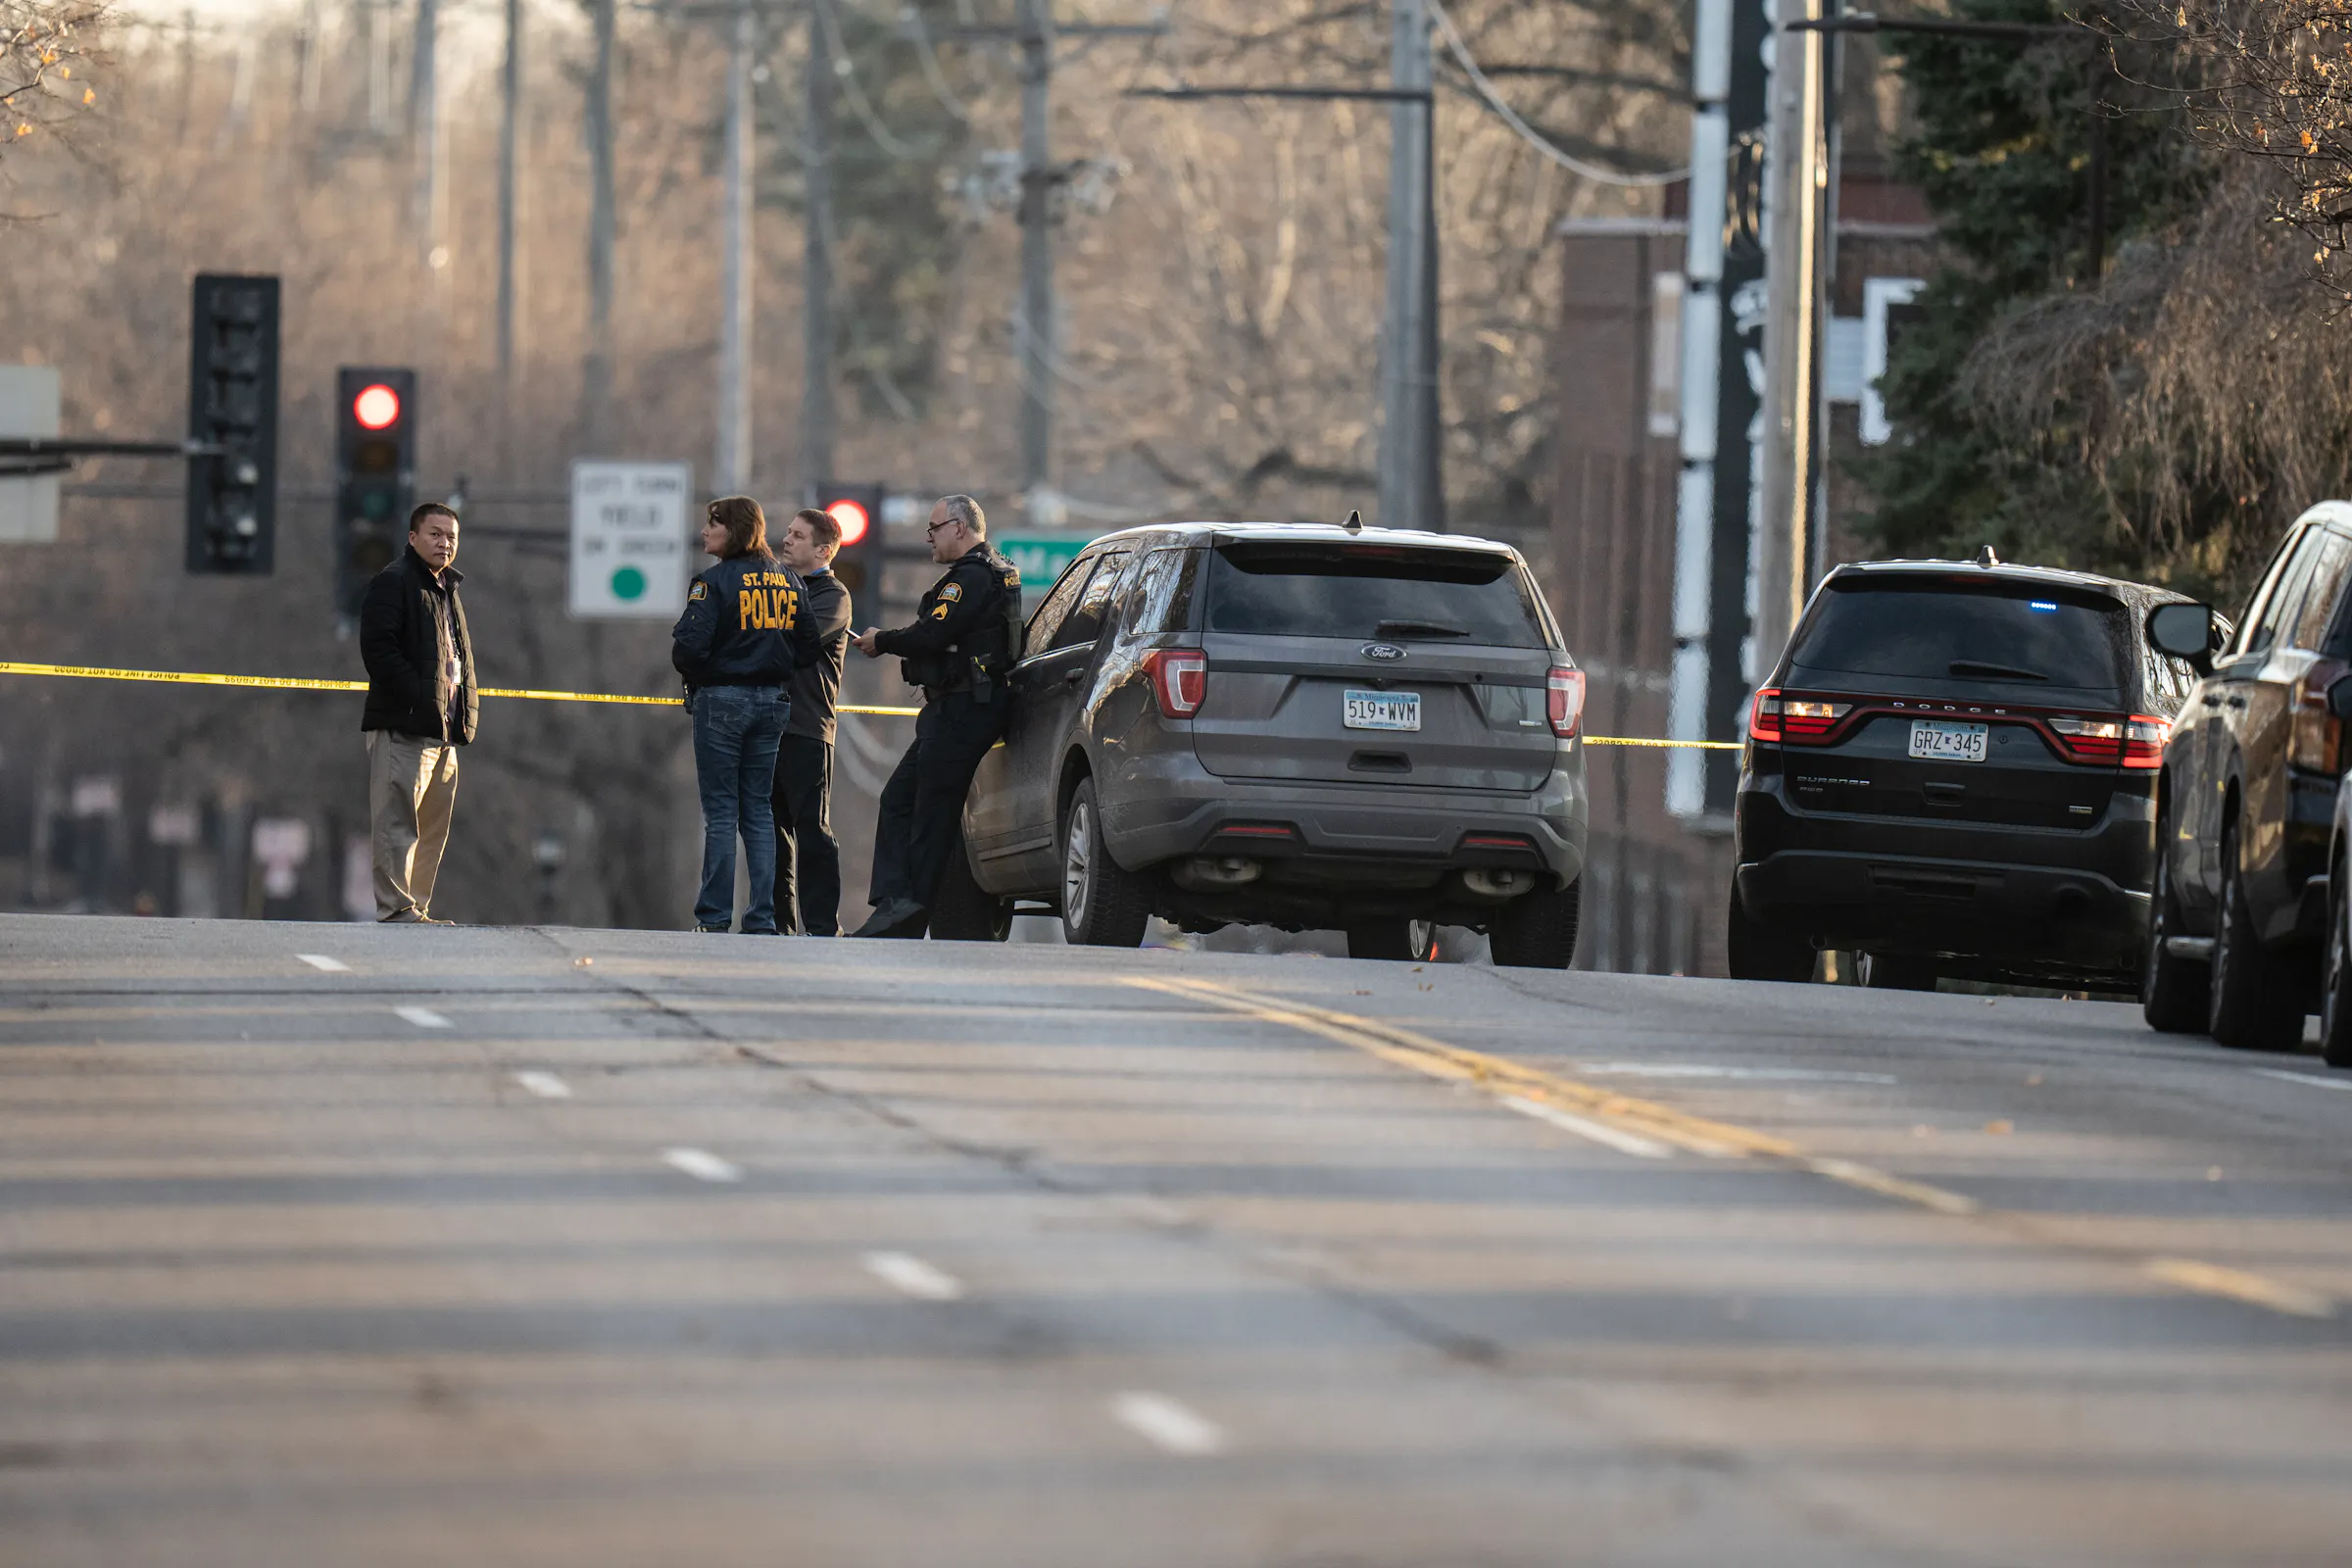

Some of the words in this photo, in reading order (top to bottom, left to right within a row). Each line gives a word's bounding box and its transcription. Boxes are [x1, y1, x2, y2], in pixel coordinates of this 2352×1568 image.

[742, 573, 761, 587] ST.
[762, 571, 791, 588] PAUL
[739, 588, 798, 630] POLICE
[1372, 647, 1396, 659] Ford
[1348, 700, 1376, 719] 519
[1388, 702, 1416, 721] WVM
[1892, 702, 2006, 715] DODGE
[1914, 730, 1943, 750] GRZ
[1953, 733, 1982, 753] 345
